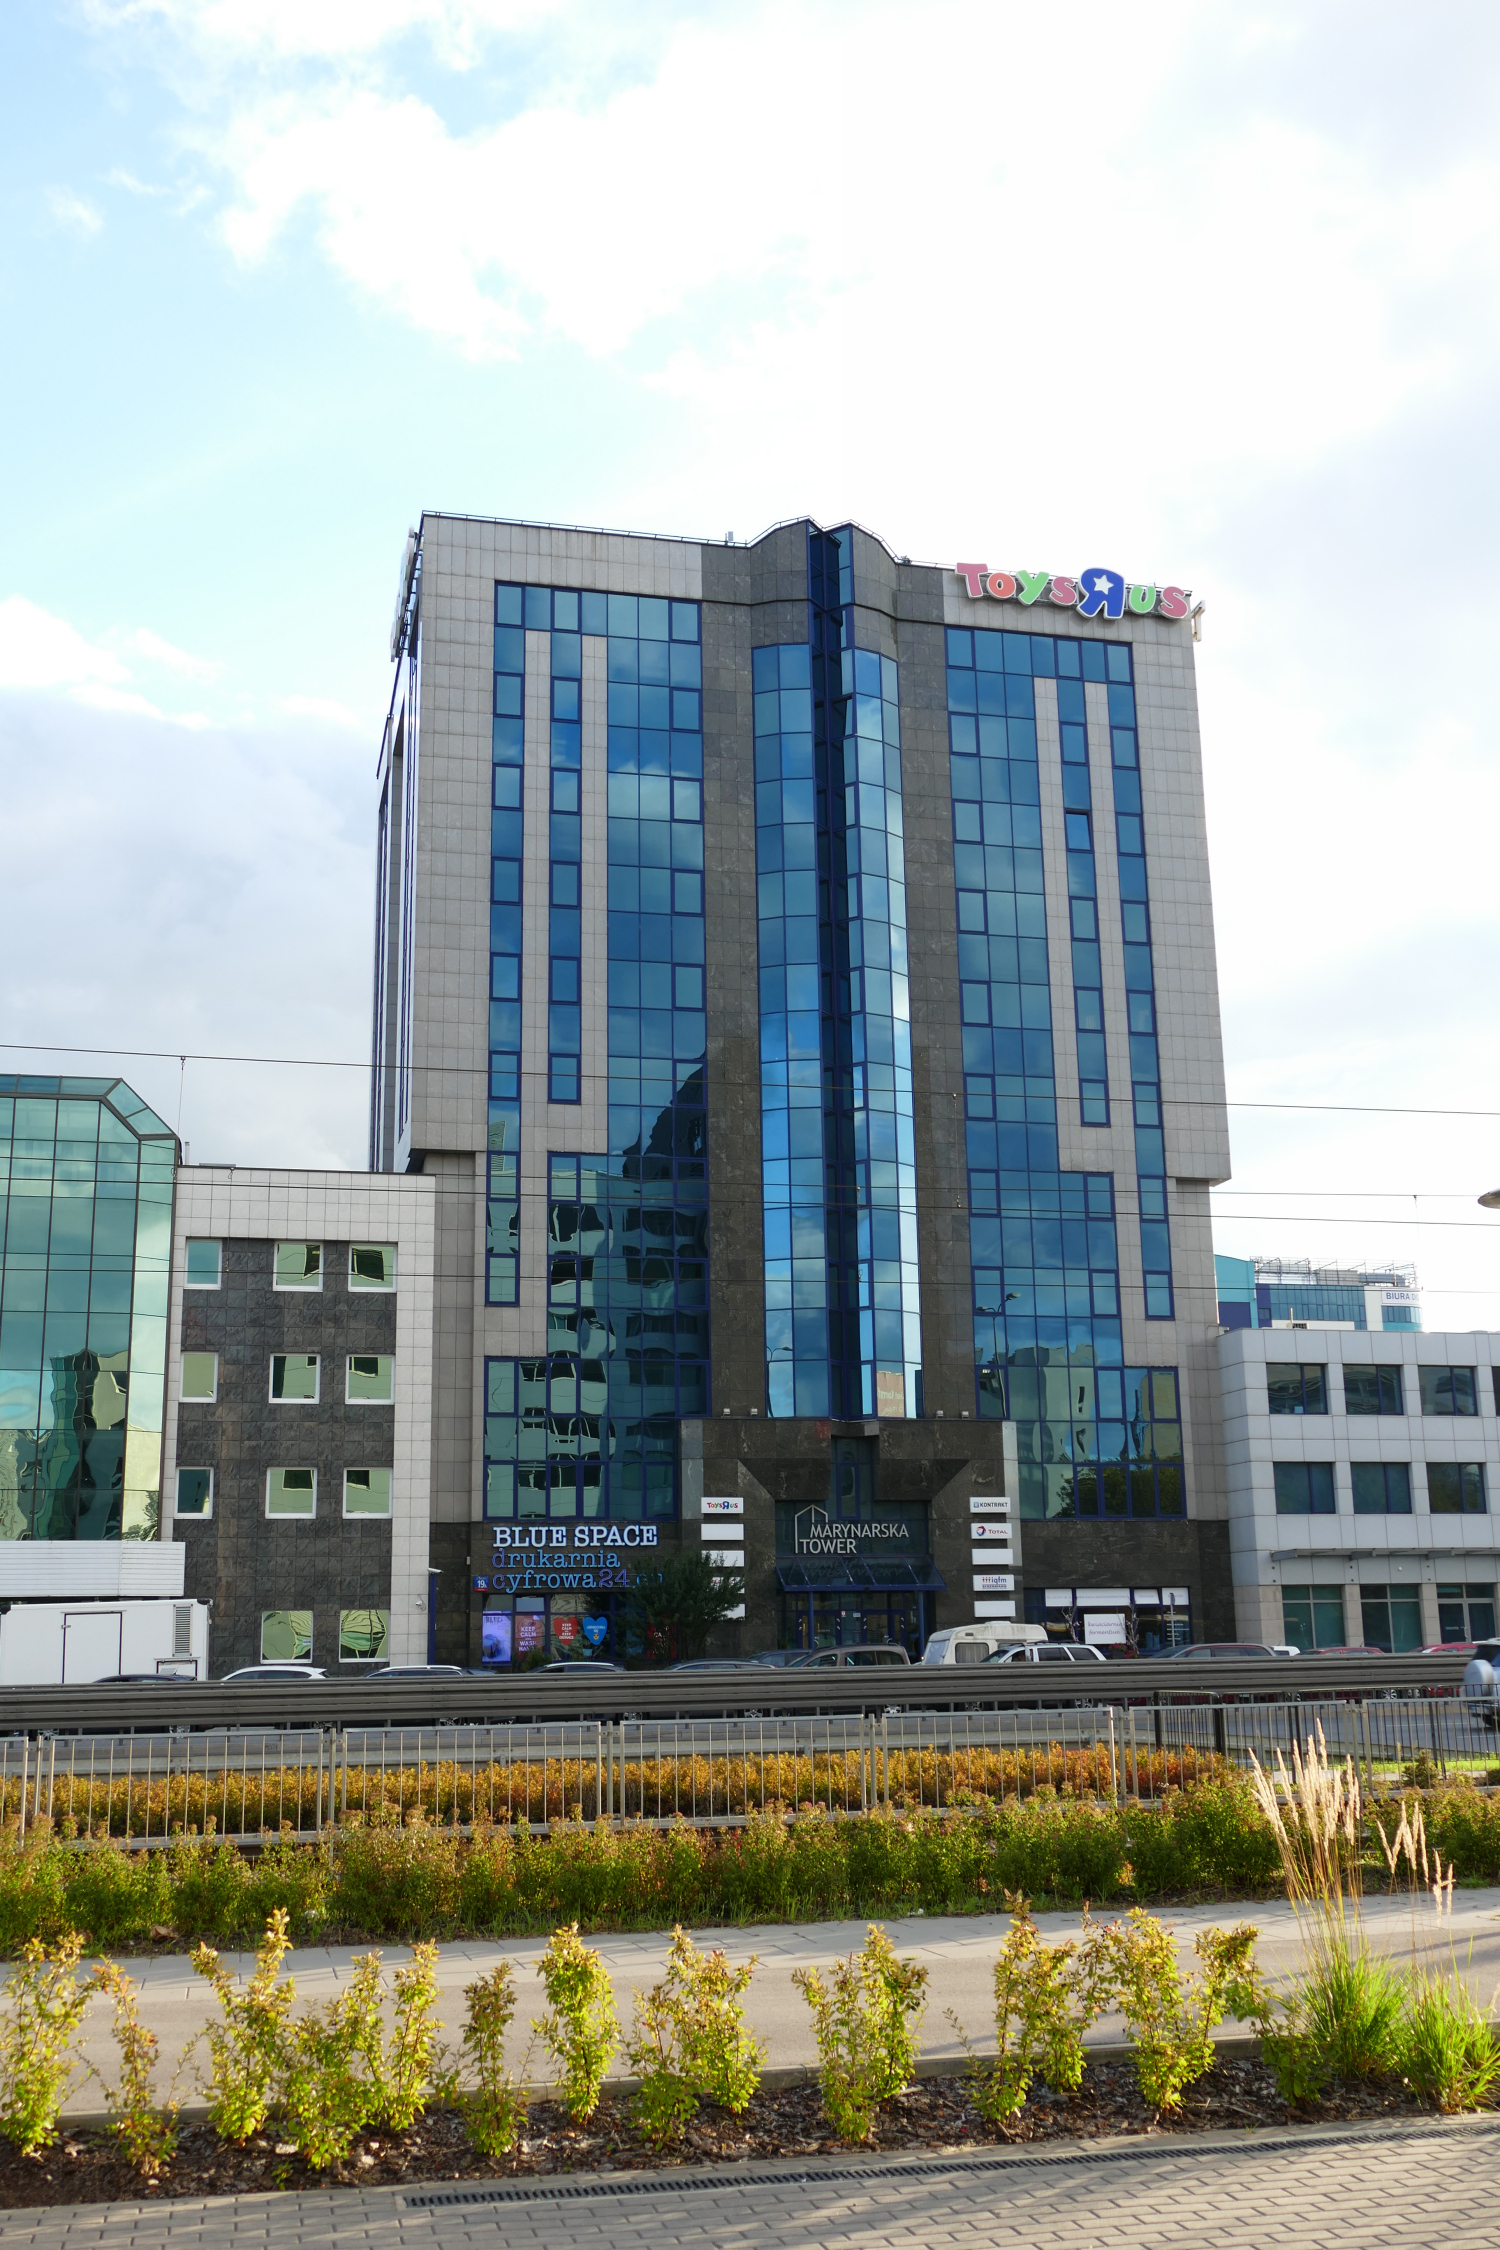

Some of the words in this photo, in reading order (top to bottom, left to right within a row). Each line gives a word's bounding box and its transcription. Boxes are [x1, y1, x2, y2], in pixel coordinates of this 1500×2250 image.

[1386, 1292, 1410, 1300] BIURA
[492, 1525, 568, 1548] BLUE
[574, 1524, 658, 1548] SPACE
[810, 1523, 909, 1538] MARYNARSKA
[799, 1539, 857, 1554] TOWER
[492, 1548, 621, 1568] drukarnia
